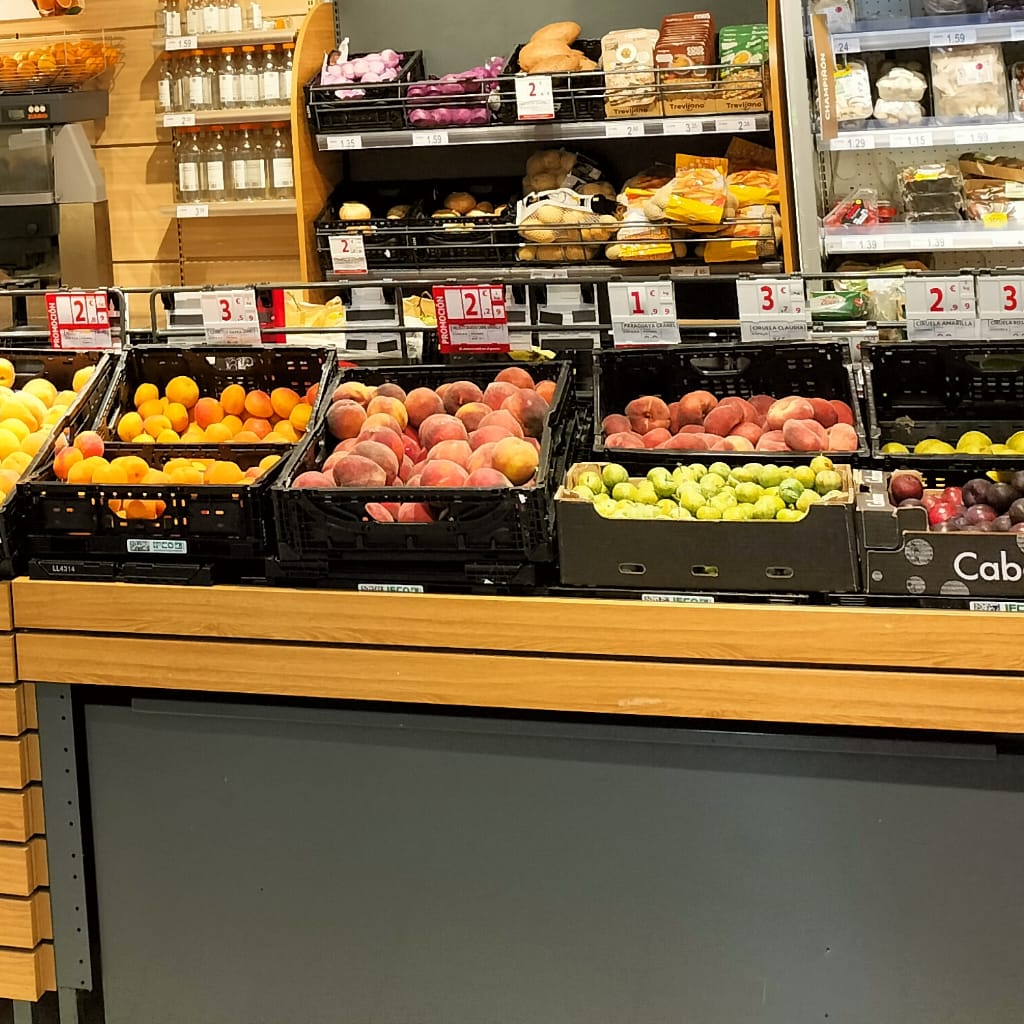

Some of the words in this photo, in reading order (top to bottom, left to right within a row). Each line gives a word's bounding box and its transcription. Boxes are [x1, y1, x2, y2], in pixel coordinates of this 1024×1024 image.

[947, 33, 965, 43] 1.59
[848, 138, 866, 148] 1.29
[219, 299, 232, 321] 3
[464, 293, 478, 316] 2
[631, 291, 645, 315] 1
[760, 285, 775, 311] 3
[930, 287, 944, 312] 2
[1003, 285, 1018, 311] 3
[74, 300, 86, 322] 2
[437, 296, 449, 345] PROMOCIÓN
[953, 550, 1023, 582] Cab
